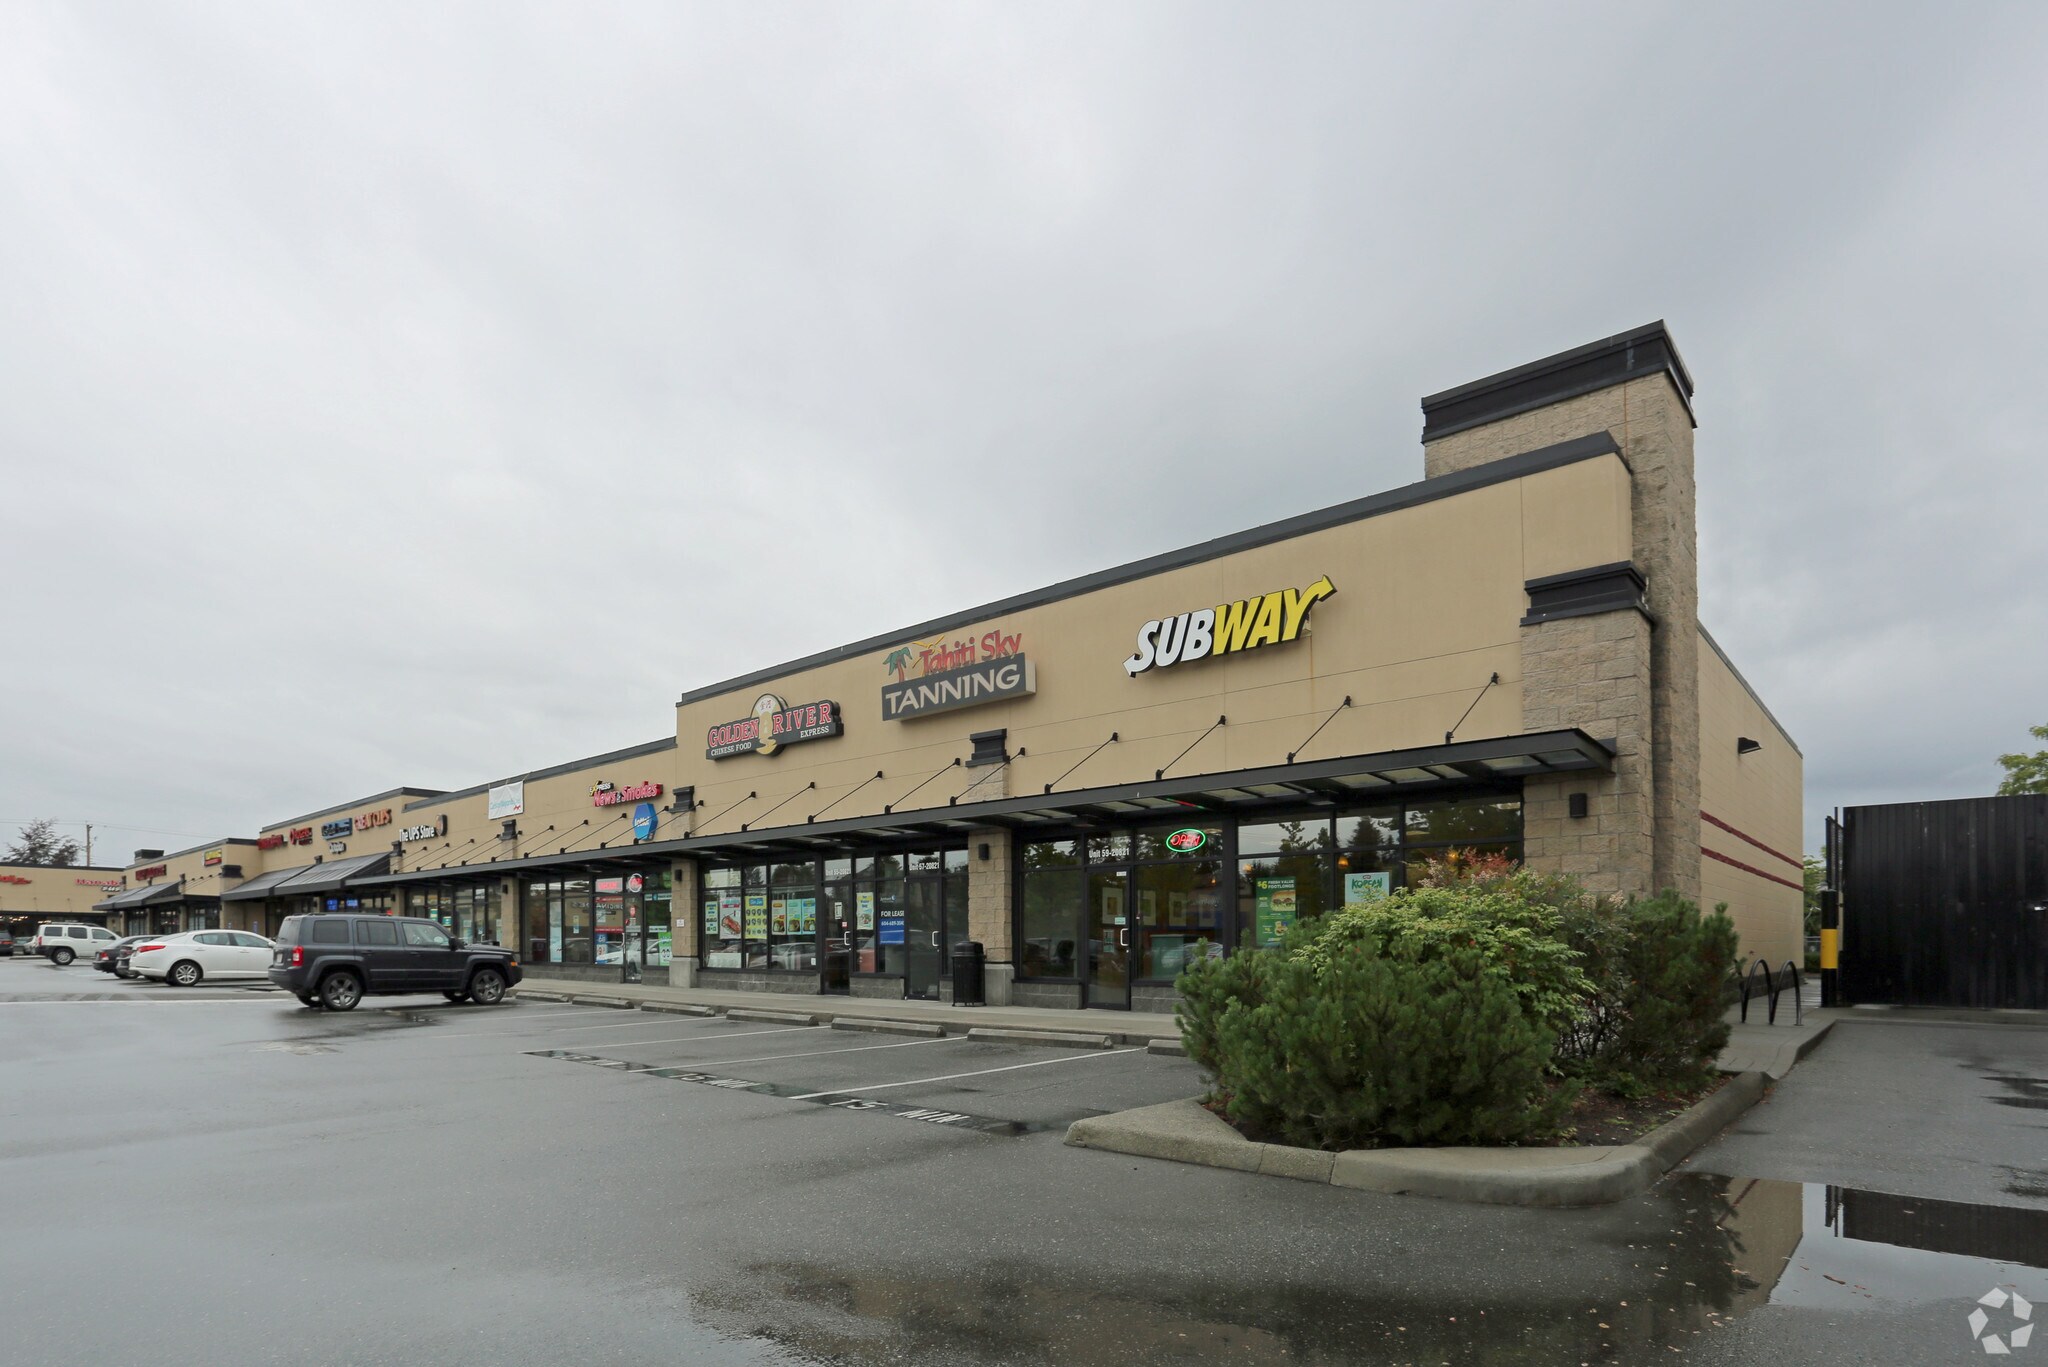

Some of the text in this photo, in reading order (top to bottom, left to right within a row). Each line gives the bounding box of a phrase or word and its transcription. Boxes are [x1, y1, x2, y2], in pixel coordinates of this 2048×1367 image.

[1122, 574, 1337, 678] SUBWAY
[920, 630, 1022, 675] Tahiti Sky
[885, 663, 1021, 715] TANNING
[708, 703, 832, 747] GOLDEN RIVER
[800, 726, 829, 738] EXPRESS
[711, 742, 752, 756] CHINESE FOOD
[593, 790, 616, 806] News
[621, 781, 657, 802] Smokes
[399, 825, 435, 842] The UPS Store
[1171, 834, 1200, 847] OPEN
[1089, 849, 1101, 858] Unit
[1257, 880, 1268, 889] $6
[829, 1099, 971, 1124] 15 MIN
